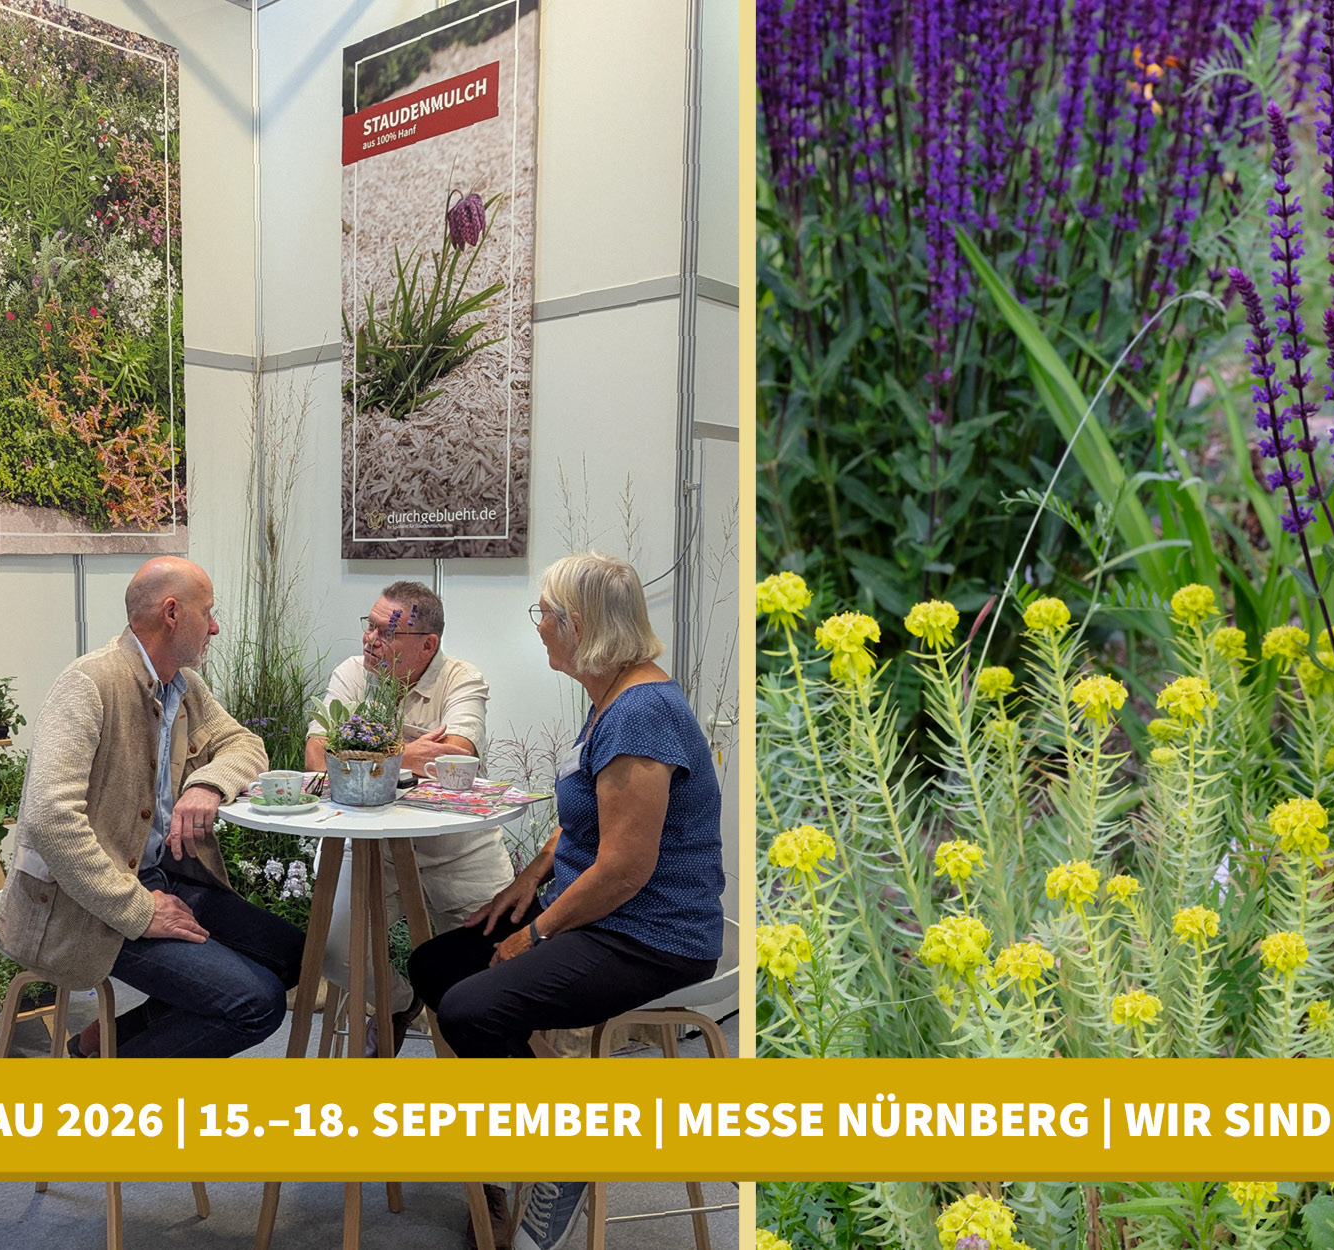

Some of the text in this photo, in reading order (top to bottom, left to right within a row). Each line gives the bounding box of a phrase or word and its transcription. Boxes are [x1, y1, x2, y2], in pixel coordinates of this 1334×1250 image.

[363, 77, 488, 136] STAUDENMULCH
[362, 124, 417, 150] aus 100% Hanf
[387, 507, 497, 524] durchgeblueht.de
